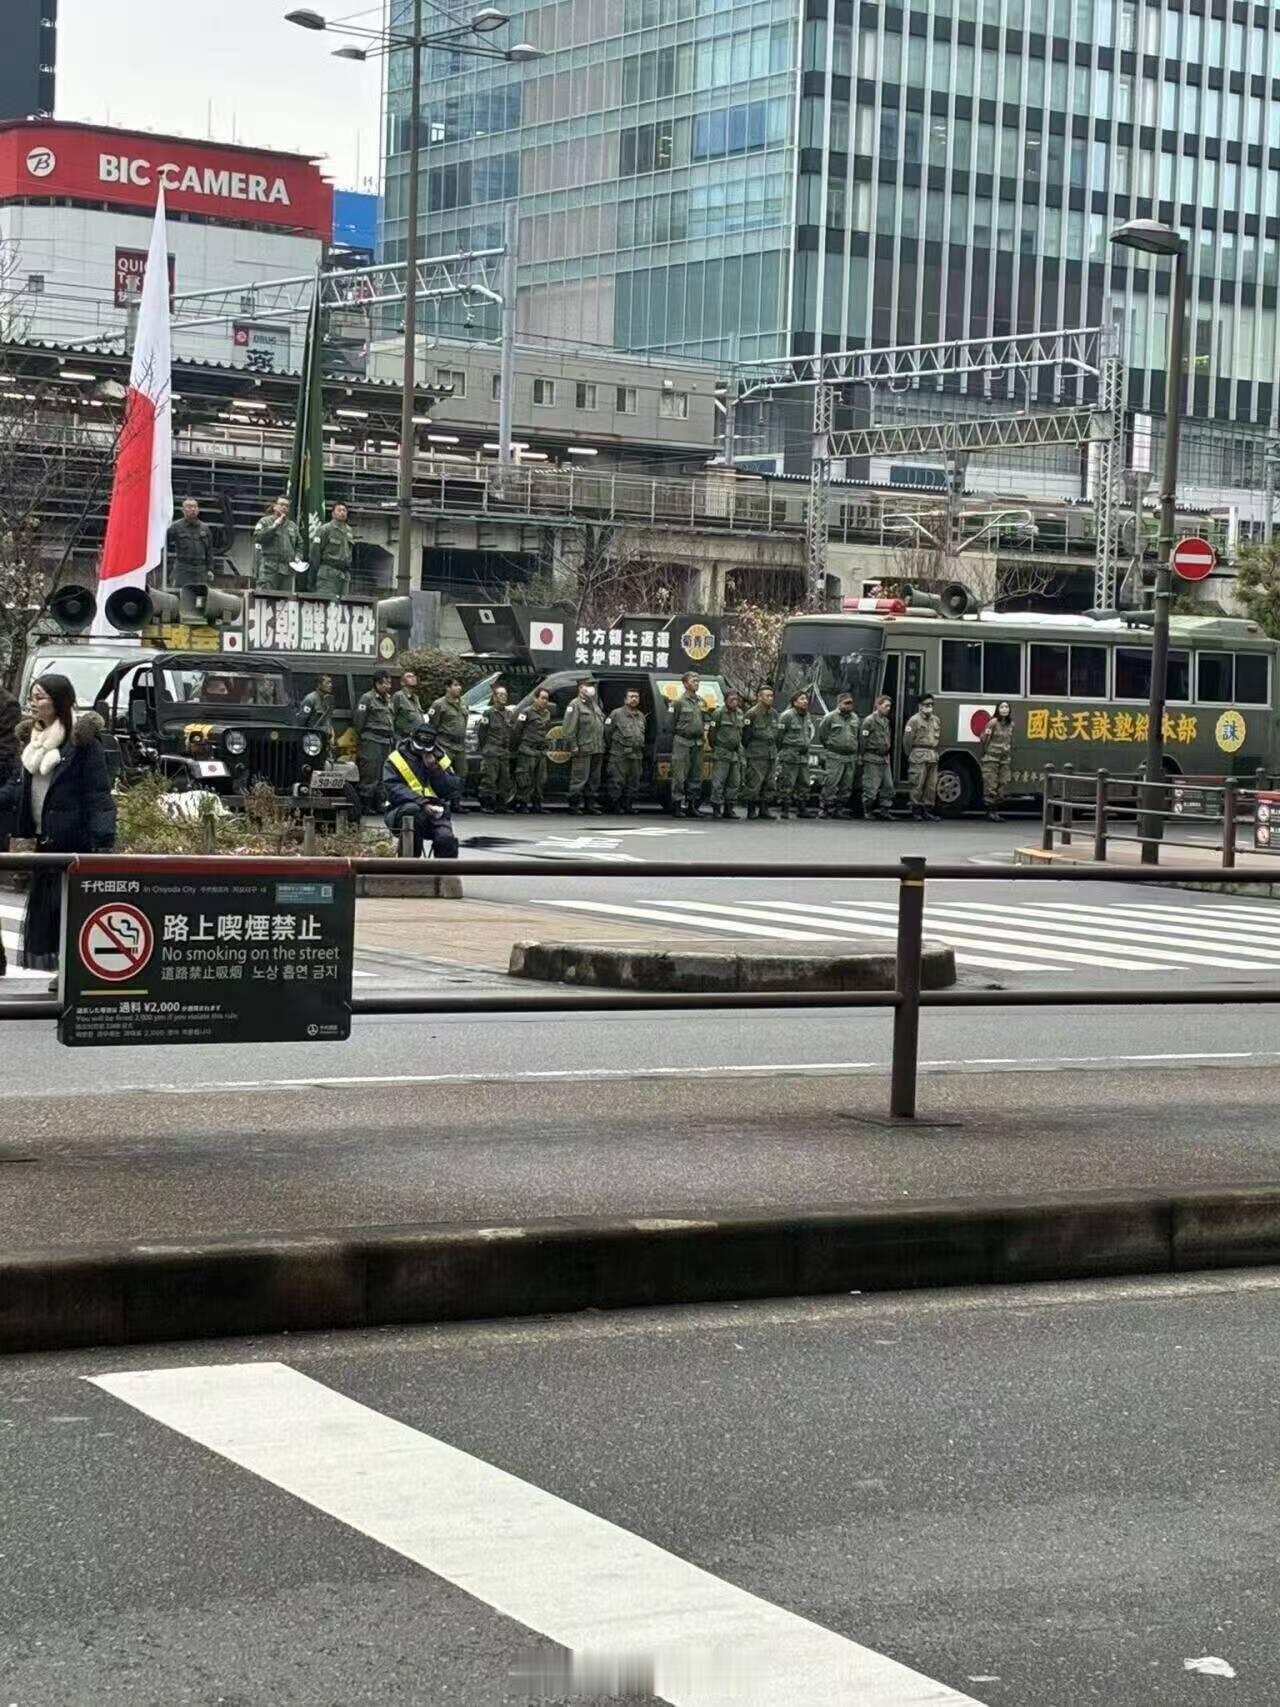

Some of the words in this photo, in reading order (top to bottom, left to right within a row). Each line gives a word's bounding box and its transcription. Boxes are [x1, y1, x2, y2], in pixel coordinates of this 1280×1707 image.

[99, 153, 151, 186] BIC
[156, 162, 291, 205] CAMERA
[117, 257, 148, 273] QUI
[248, 600, 375, 654] 北朝鮮粉砕
[575, 627, 670, 649] 北方領土返還
[575, 648, 670, 668] 失地領土回復
[81, 880, 140, 893] 千代田区内
[162, 914, 322, 941] 路上喫煙禁止
[161, 947, 182, 961] No
[186, 946, 246, 963] smoking
[251, 949, 271, 960] on
[273, 946, 296, 960] the
[299, 947, 340, 960] street
[161, 965, 242, 980] 道路禁止吸烟
[252, 965, 279, 980] 노상
[282, 964, 308, 979] 흡연
[312, 964, 338, 979] 금지
[144, 1001, 180, 1013] ¥2,000
